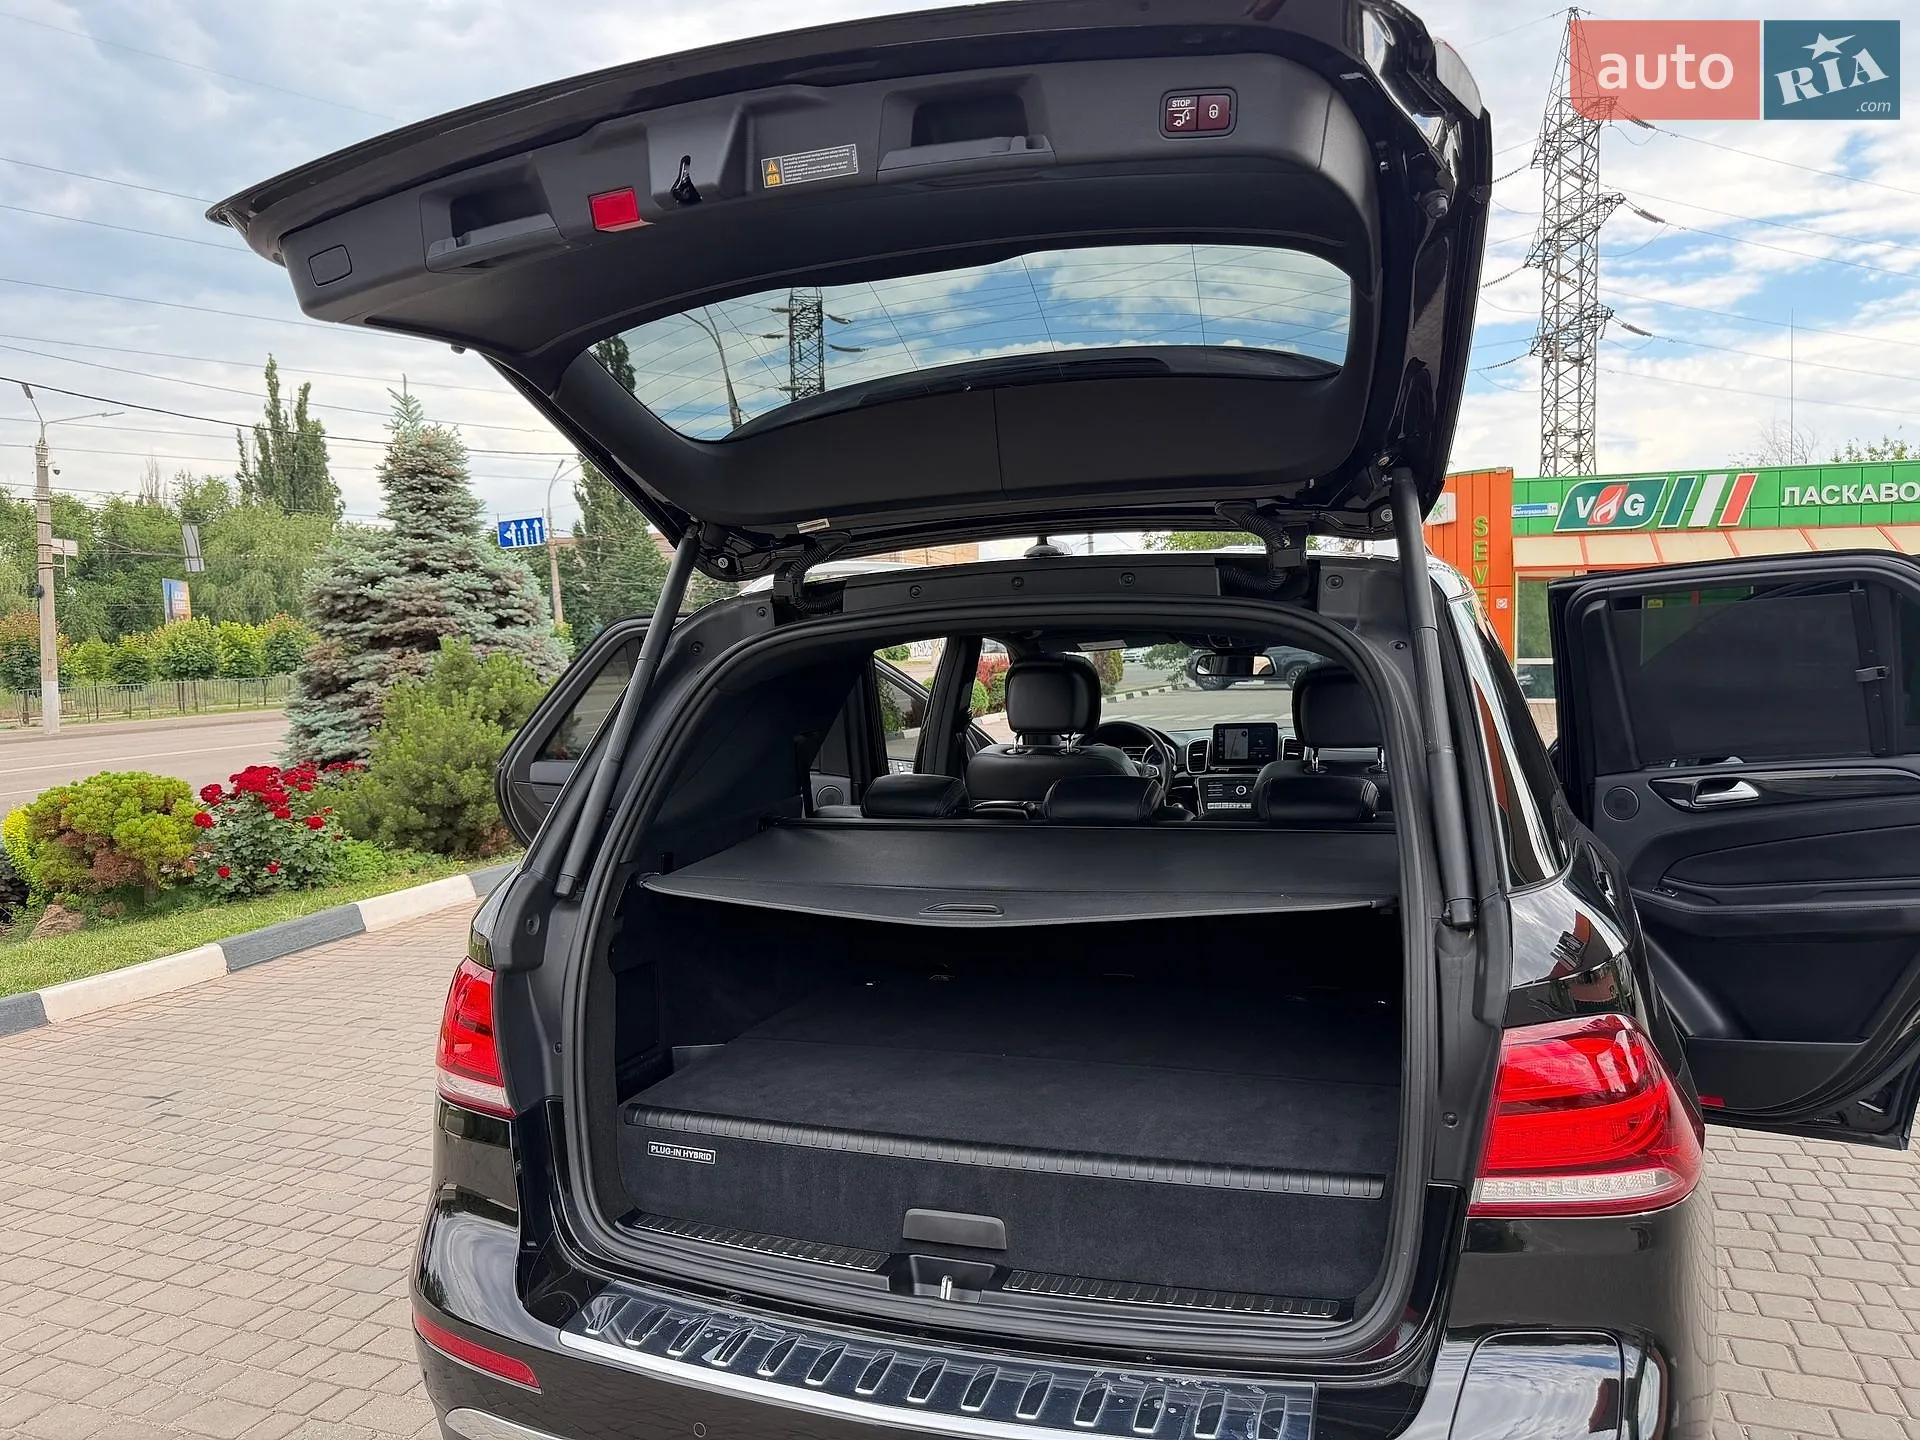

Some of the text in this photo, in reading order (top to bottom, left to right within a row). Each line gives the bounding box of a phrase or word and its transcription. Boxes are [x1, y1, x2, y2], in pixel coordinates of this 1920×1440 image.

[1172, 99, 1191, 108] STOP
[650, 1145, 712, 1161] PLUG-IN HYBRID
